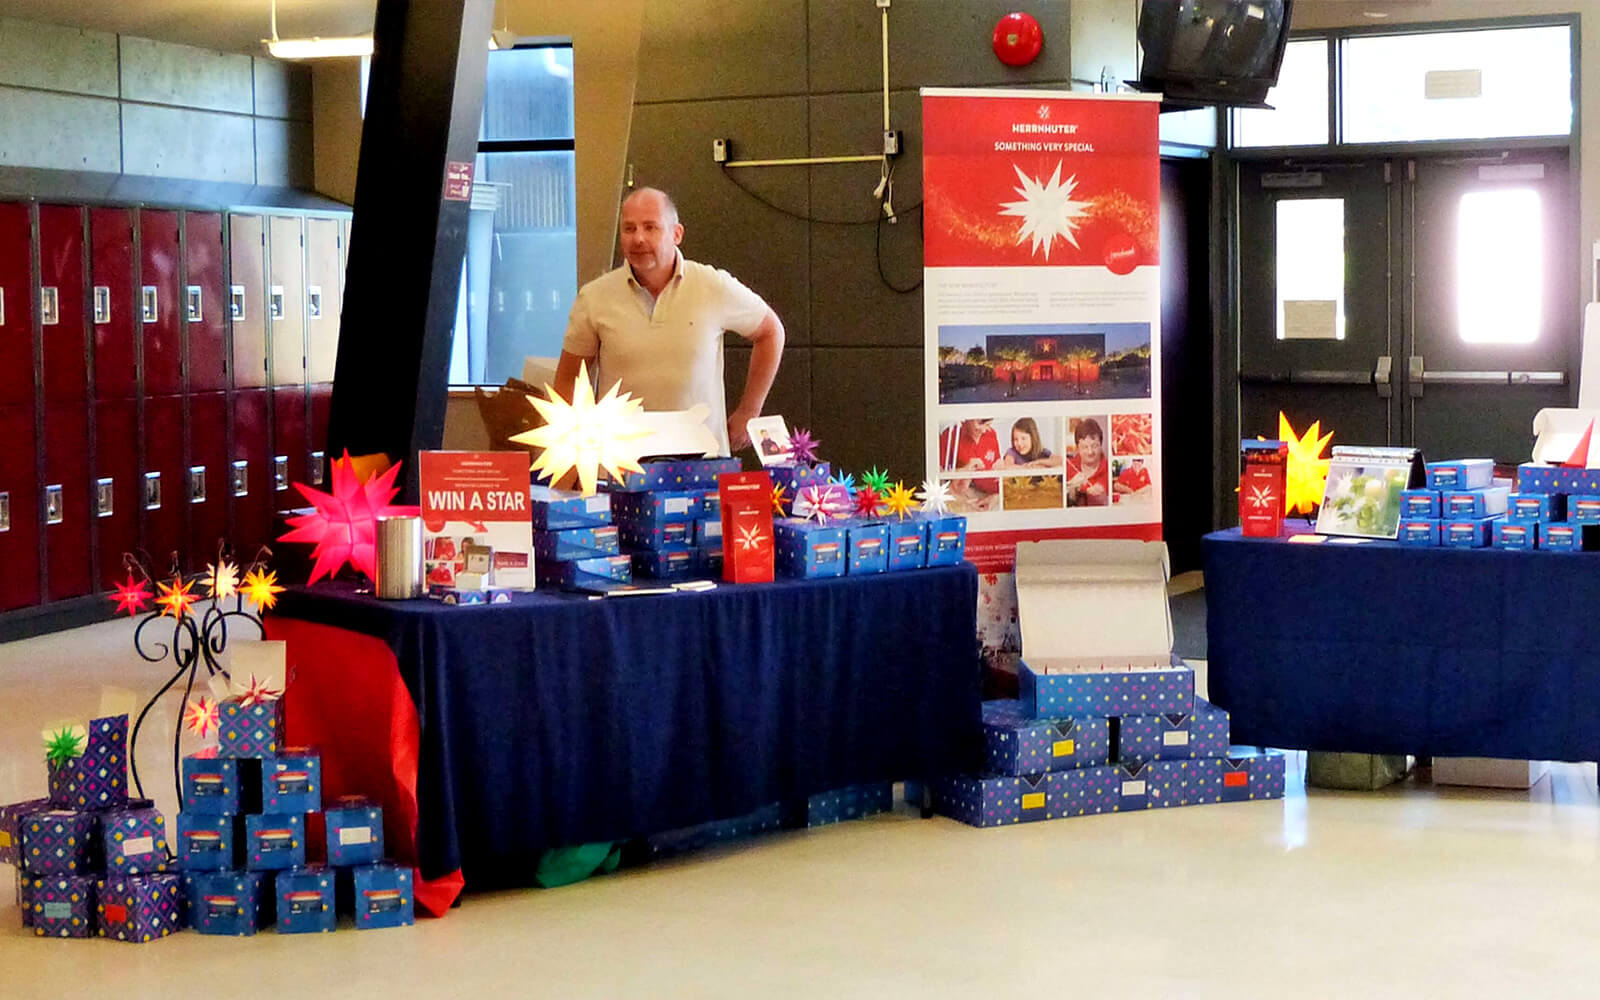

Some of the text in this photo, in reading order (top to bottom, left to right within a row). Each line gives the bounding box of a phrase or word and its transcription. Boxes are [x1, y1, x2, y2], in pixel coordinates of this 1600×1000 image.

[994, 141, 1095, 152] SOMETHING VERY SPECIAL
[428, 490, 525, 511] WIN A STAR
